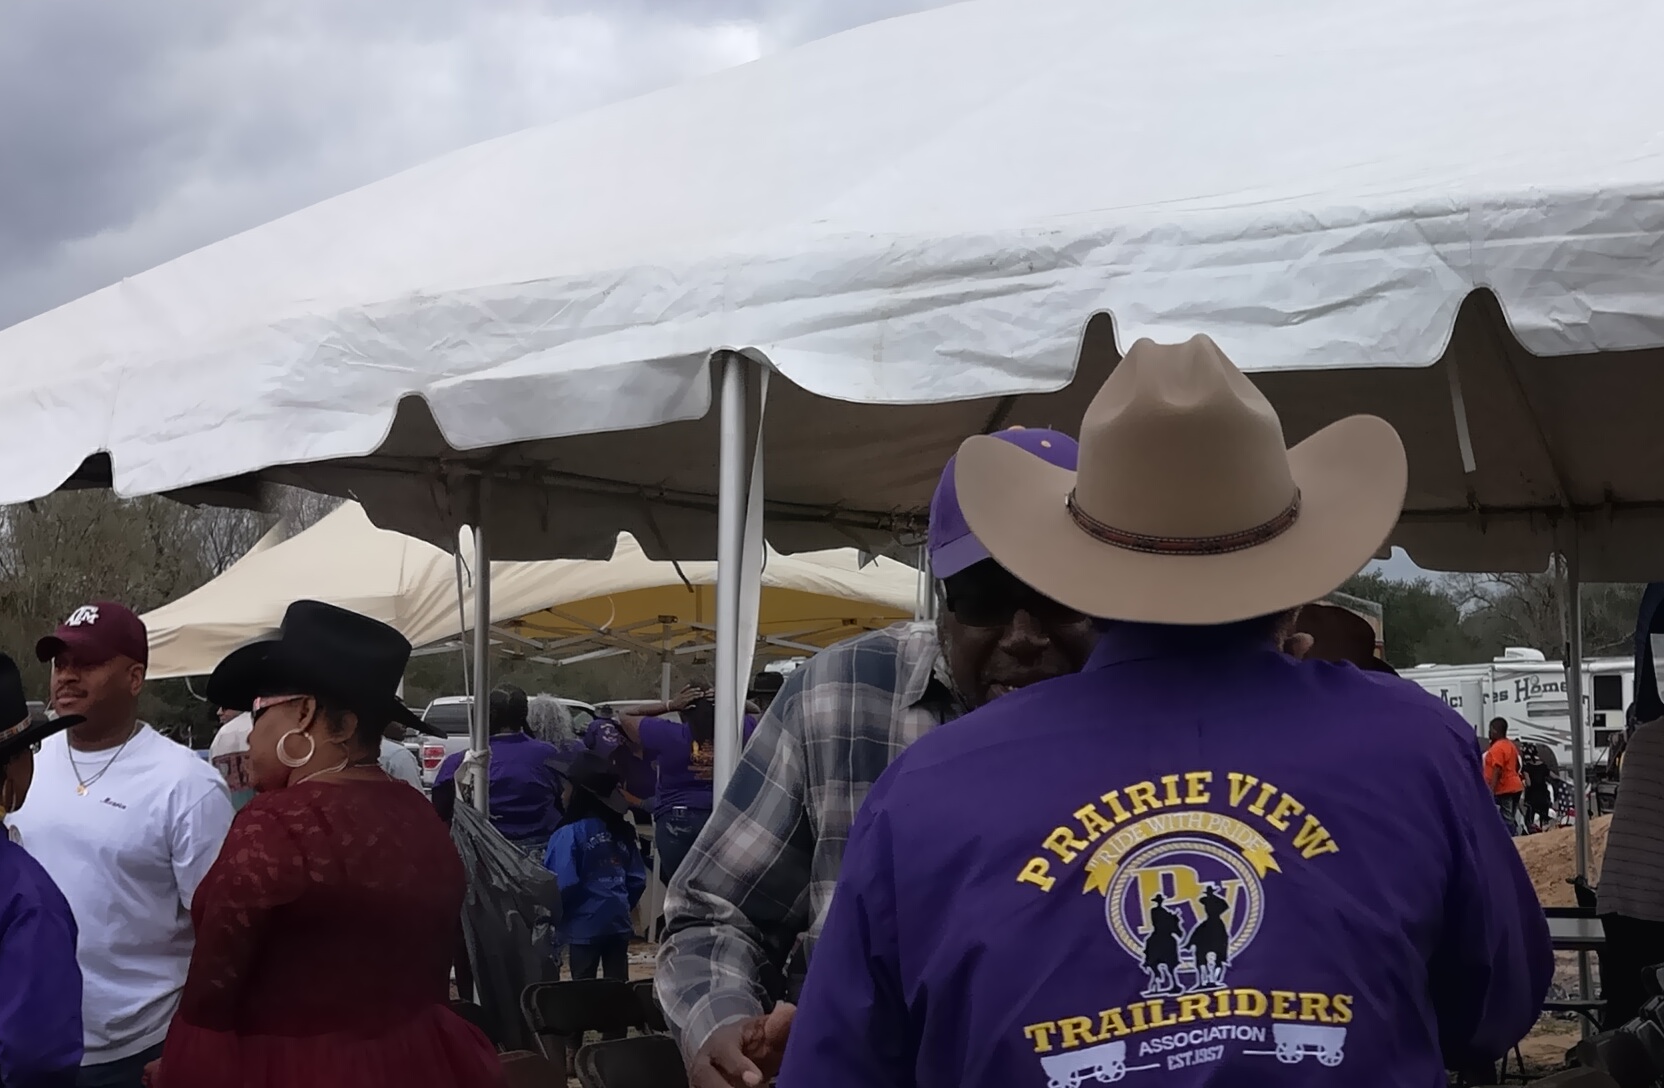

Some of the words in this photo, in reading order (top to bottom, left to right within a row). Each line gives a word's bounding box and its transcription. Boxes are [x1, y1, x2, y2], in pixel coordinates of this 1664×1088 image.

[1016, 771, 1213, 893] PRAIRIE
[1227, 772, 1340, 860] VIEW
[1146, 811, 1210, 834] WITH
[1138, 1025, 1266, 1058] ASSOCIATION
